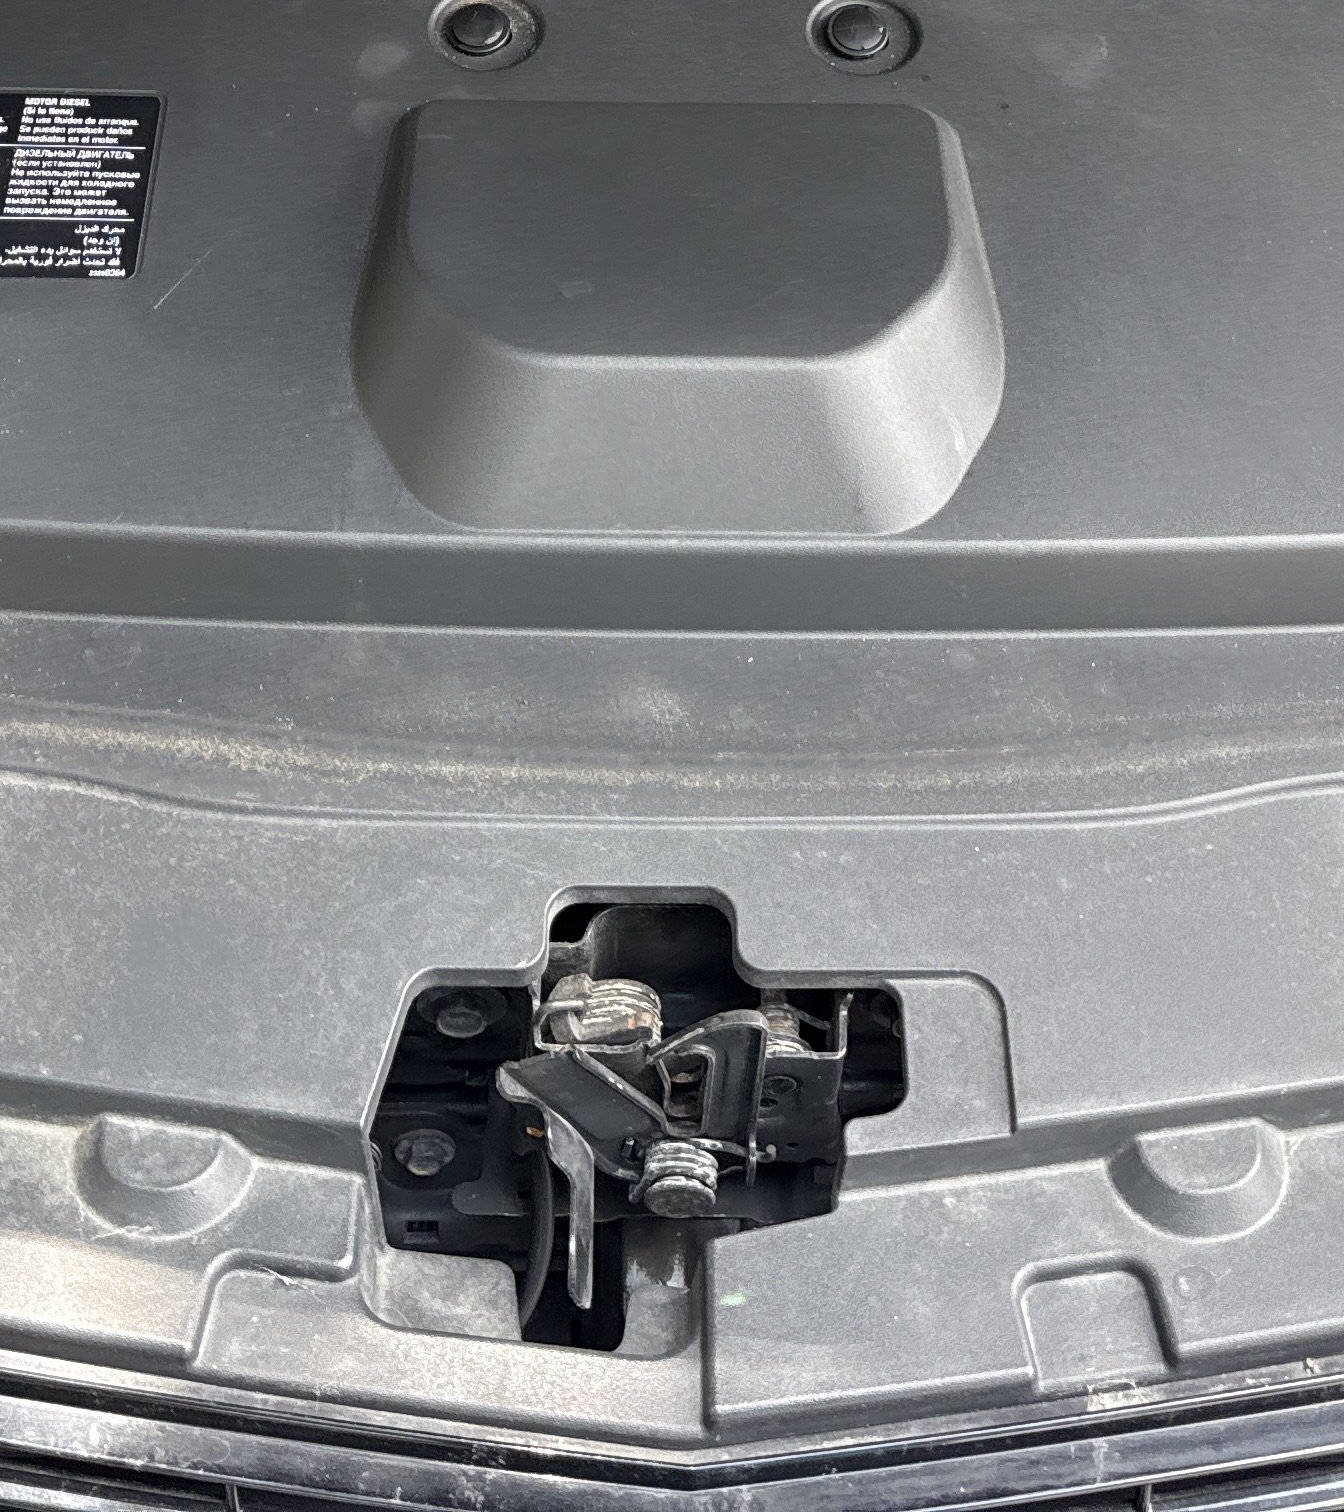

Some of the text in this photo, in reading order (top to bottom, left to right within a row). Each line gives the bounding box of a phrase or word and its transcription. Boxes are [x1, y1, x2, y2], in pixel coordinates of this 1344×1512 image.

[24, 97, 59, 106] MOTOR
[32, 125, 66, 134] pueden
[67, 126, 105, 135] producir
[76, 150, 135, 160] ДВИГАТЕЛЬ
